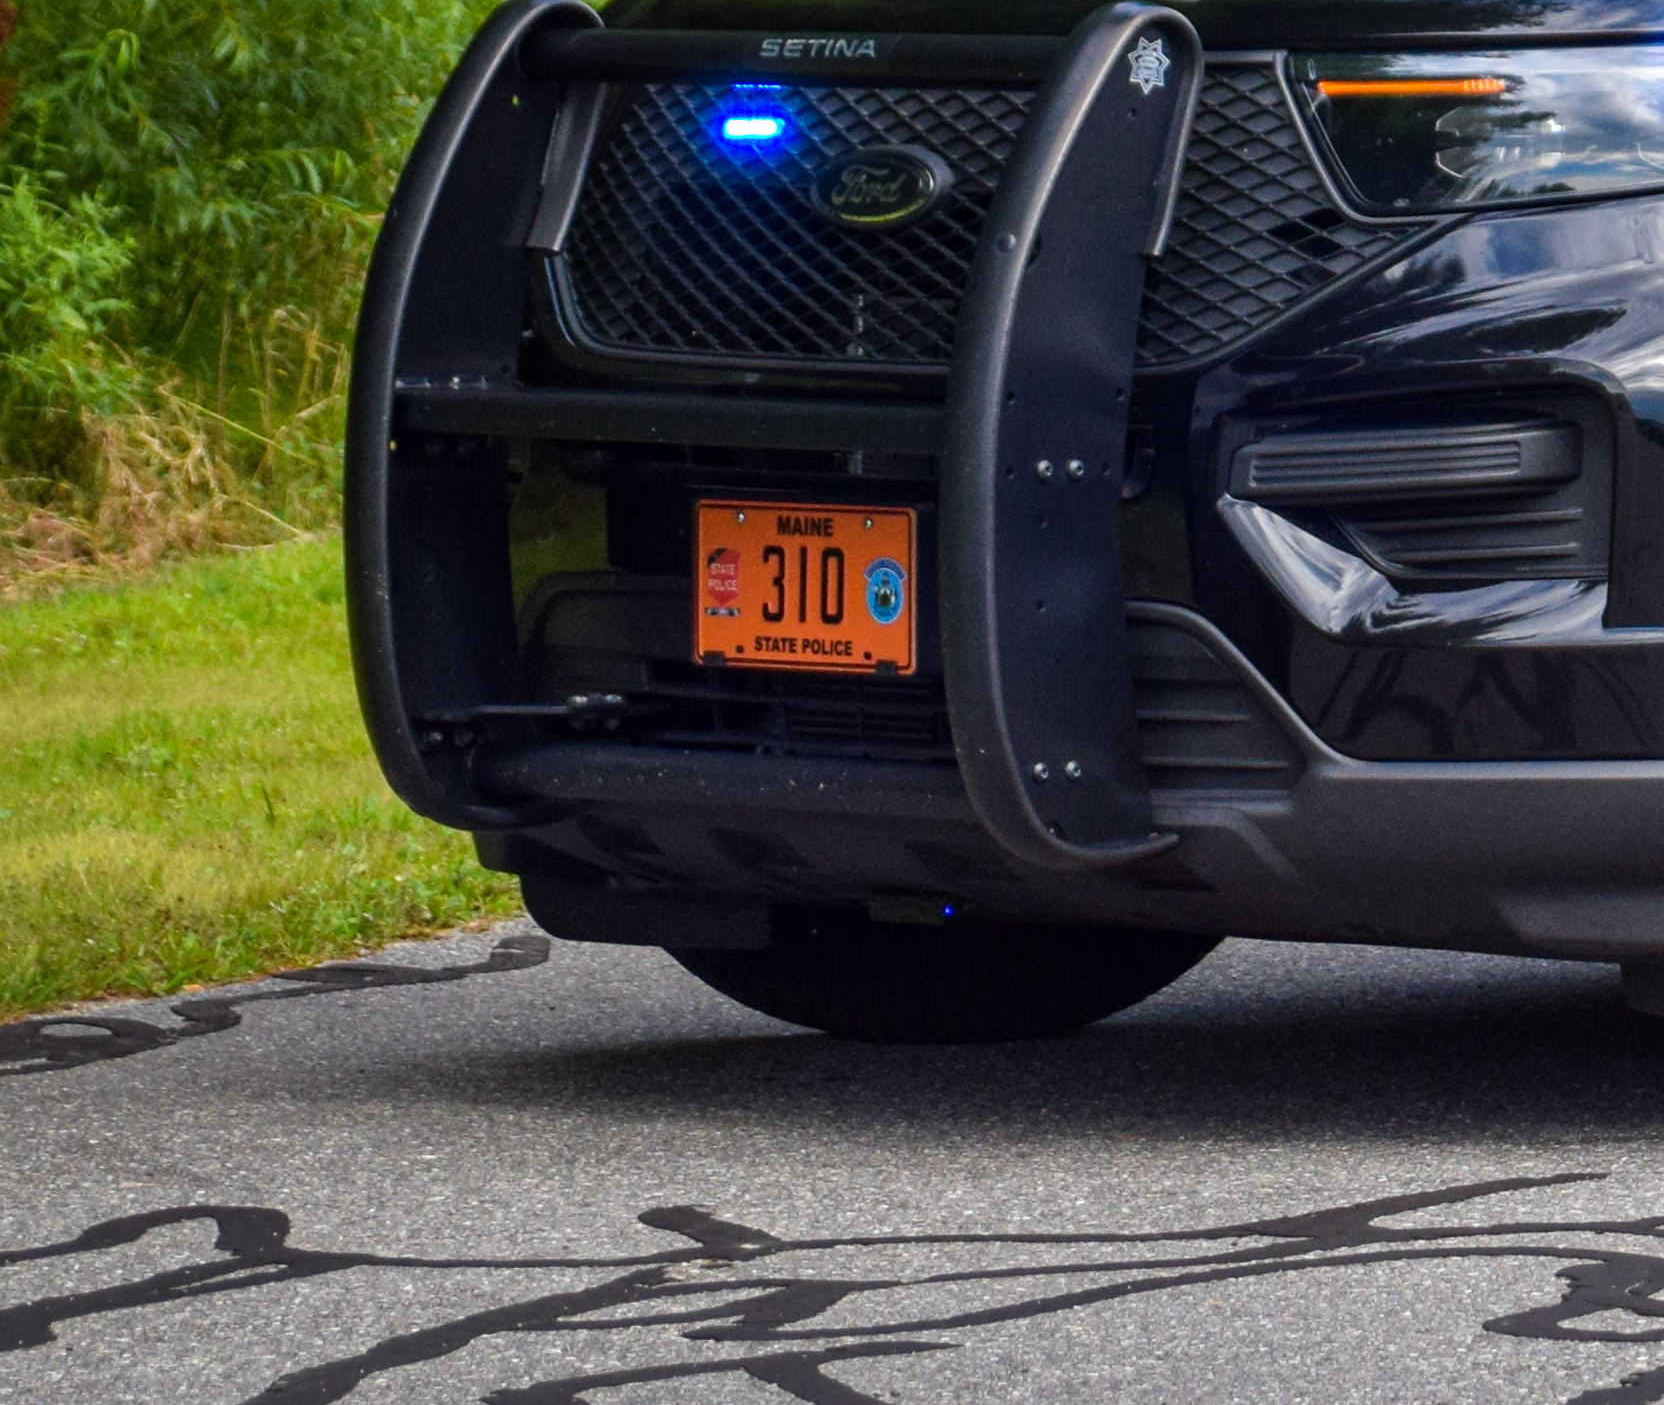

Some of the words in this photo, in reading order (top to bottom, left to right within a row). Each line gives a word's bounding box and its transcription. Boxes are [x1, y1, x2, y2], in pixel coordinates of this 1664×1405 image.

[760, 38, 876, 59] SETINA
[831, 165, 907, 205] Ford
[777, 515, 834, 538] MAINE
[710, 563, 736, 575] STATE
[708, 578, 738, 591] POLICE
[762, 545, 845, 625] 310
[754, 635, 797, 654] STATE
[802, 638, 853, 657] POLICE
